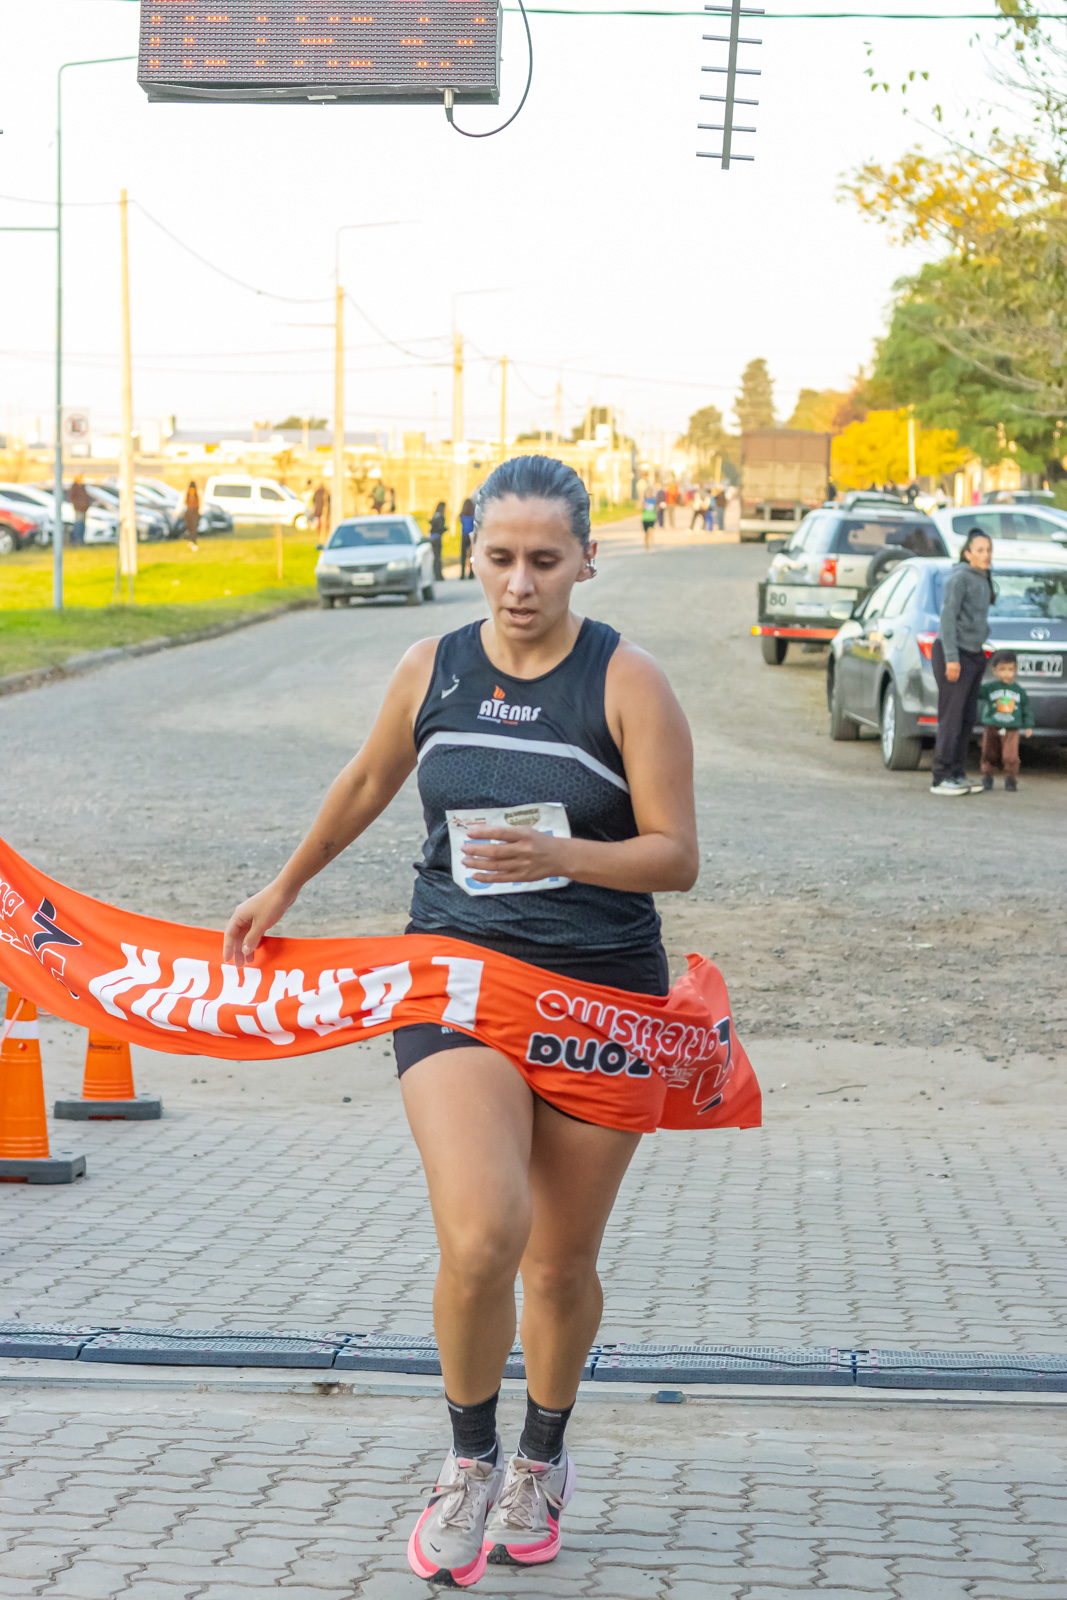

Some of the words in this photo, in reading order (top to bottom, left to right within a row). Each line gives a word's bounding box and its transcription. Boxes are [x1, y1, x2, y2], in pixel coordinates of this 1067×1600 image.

[769, 592, 787, 606] 80
[479, 698, 542, 722] ATENAS
[536, 989, 719, 1068] atletismo
[526, 1032, 652, 1078] zona
